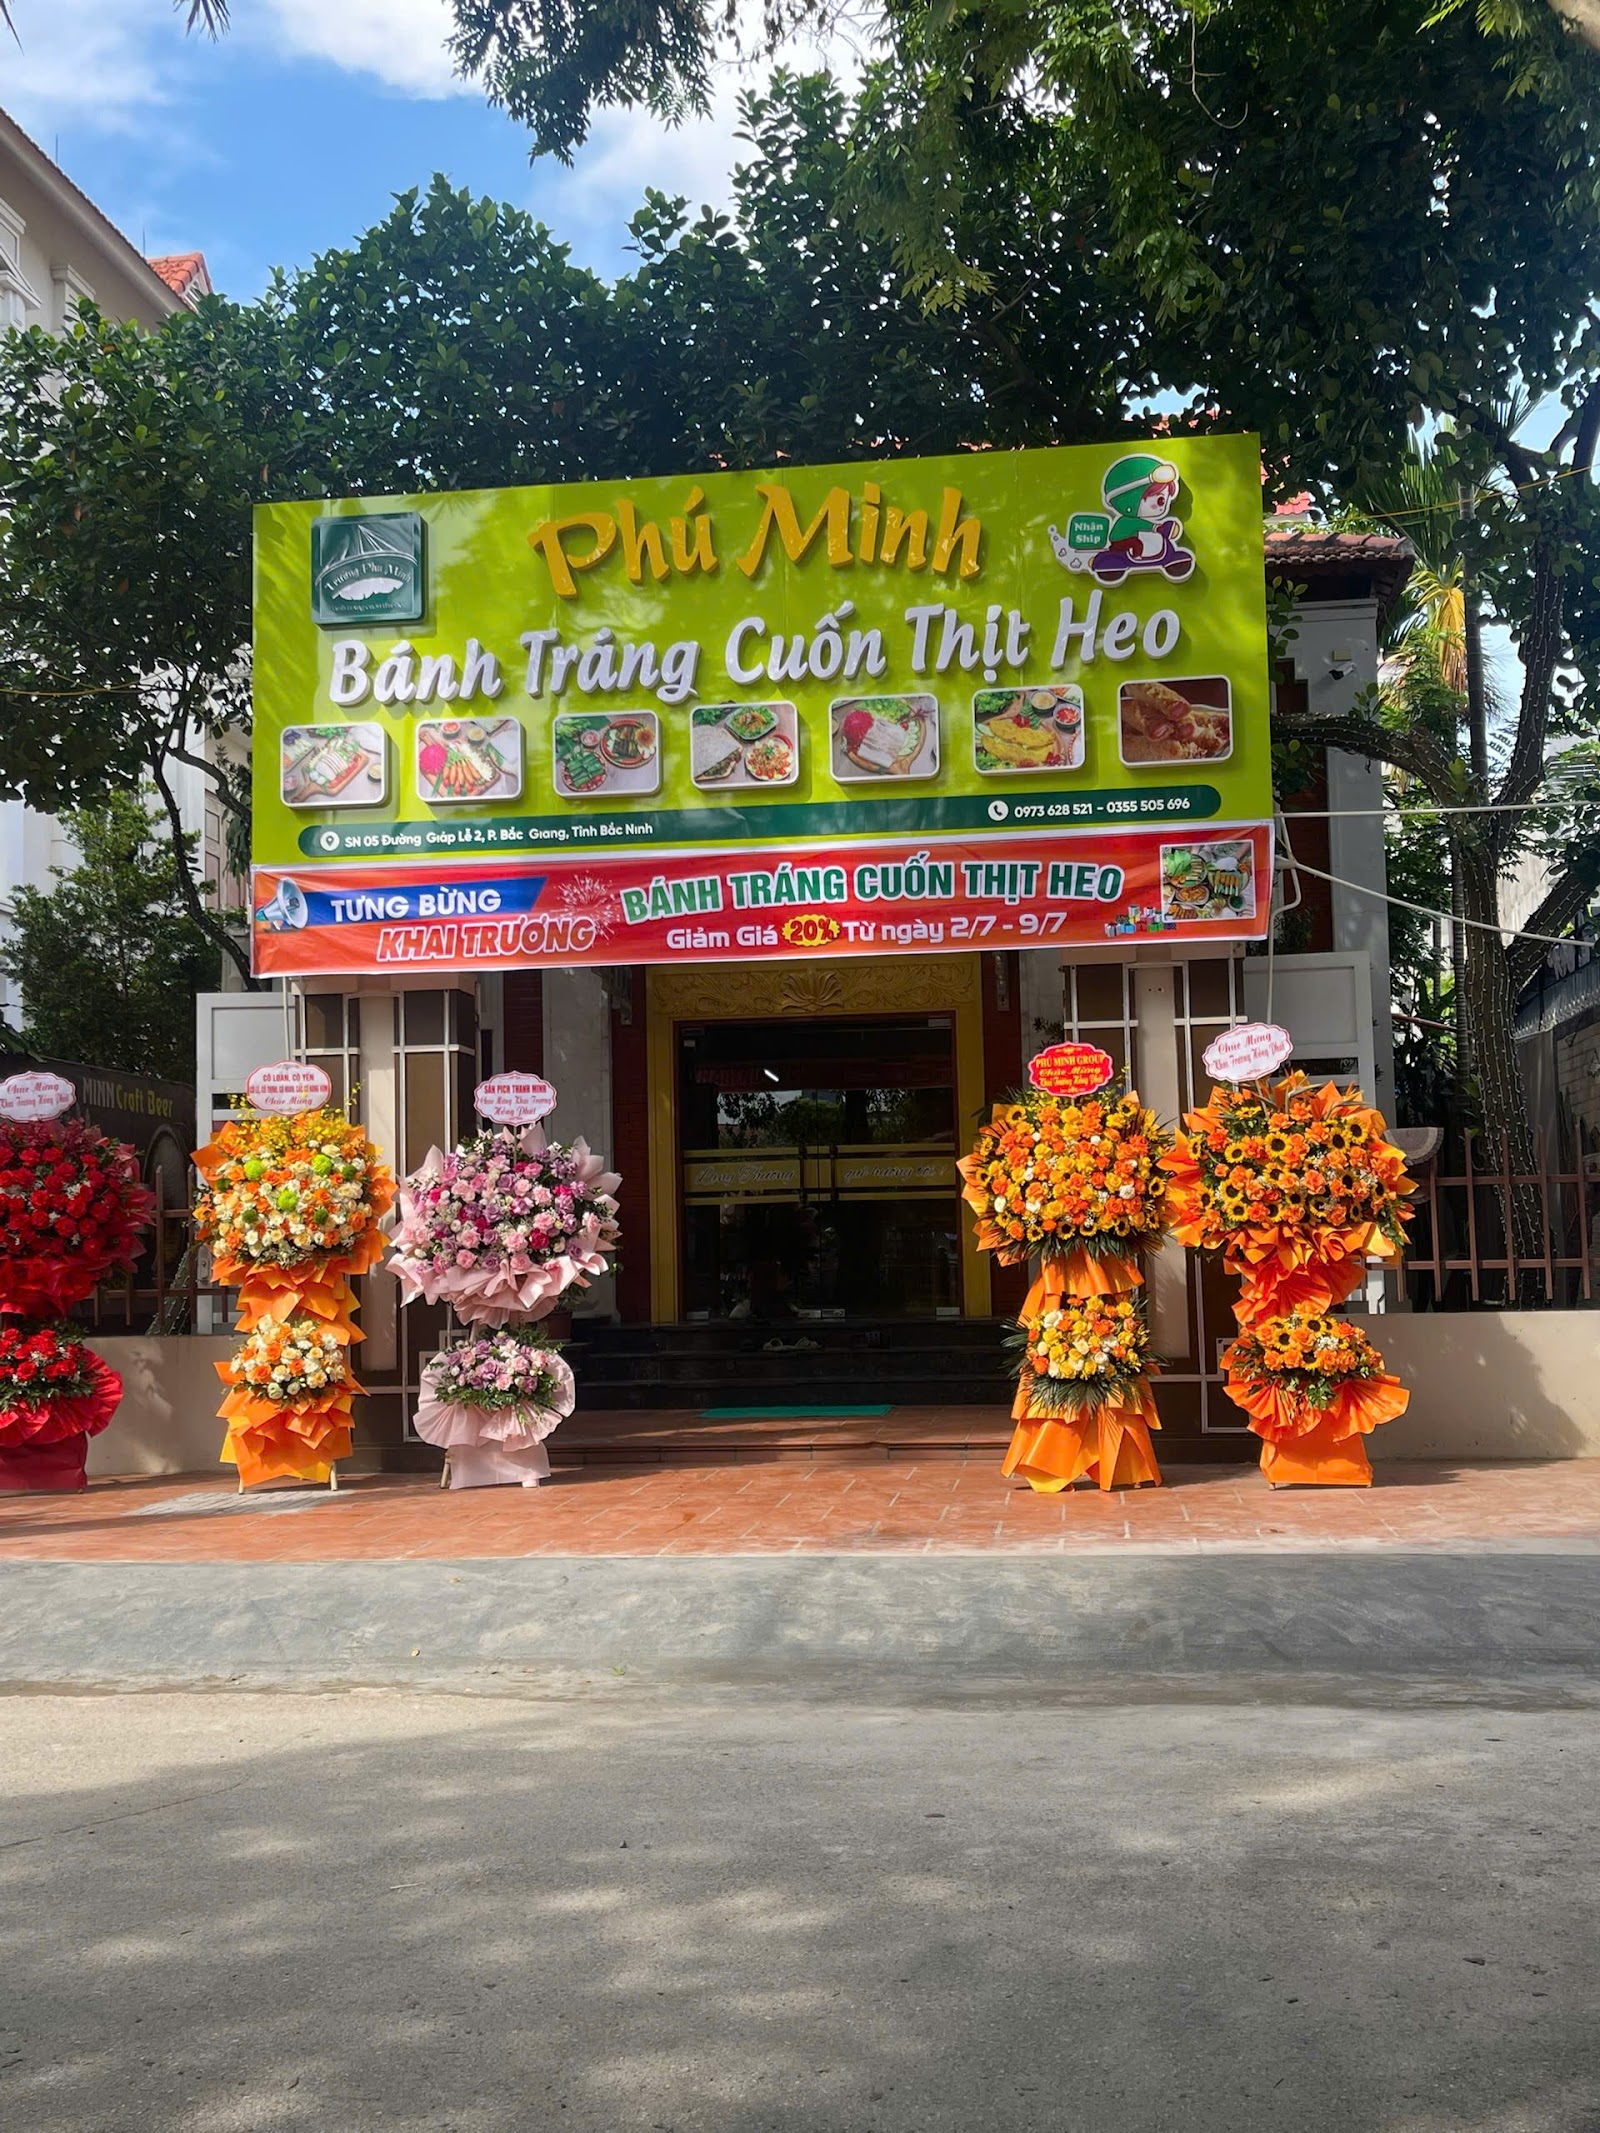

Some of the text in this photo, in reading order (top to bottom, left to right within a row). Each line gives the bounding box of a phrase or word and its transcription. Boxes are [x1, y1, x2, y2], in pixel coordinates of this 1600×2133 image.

[527, 481, 980, 600] Phú Minh
[1074, 521, 1104, 533] Nhận
[1075, 534, 1101, 545] Ship
[329, 589, 1181, 705] Bánh Tráng Cuốn Thịt Heo
[1014, 804, 1045, 819] 0973
[1047, 803, 1070, 817] 628
[1072, 802, 1093, 815] 521
[1106, 800, 1138, 814] 0355
[1140, 798, 1165, 812] 505
[1167, 796, 1190, 810] 696
[344, 836, 361, 849] SN
[363, 834, 379, 847] 05
[381, 833, 422, 849] Đường
[425, 831, 456, 846] Giáp
[474, 829, 486, 844] 2,
[487, 829, 498, 842] P.
[500, 826, 524, 842] Bắc
[528, 826, 570, 844] Giang,
[600, 822, 624, 837] Bắc
[625, 822, 653, 836] Ninh
[331, 886, 502, 923] TƯNG BỪNG
[621, 851, 1126, 925] BÁNH TRÁNG CUỐN THỊT HEO
[377, 914, 596, 963] KHAI TRƯƠNG
[666, 927, 730, 949] Giảm
[736, 924, 778, 947] Giá
[789, 917, 836, 942] 20%
[842, 920, 876, 942] Từ
[881, 918, 944, 944] ngày
[950, 915, 997, 939] 2/7
[1019, 912, 1068, 936] 9/7
[1035, 1053, 1105, 1068] PHÚ MINH GROUP
[116, 1084, 145, 1114] Craft
[147, 1089, 174, 1118] Beer
[532, 1084, 547, 1094] MINH
